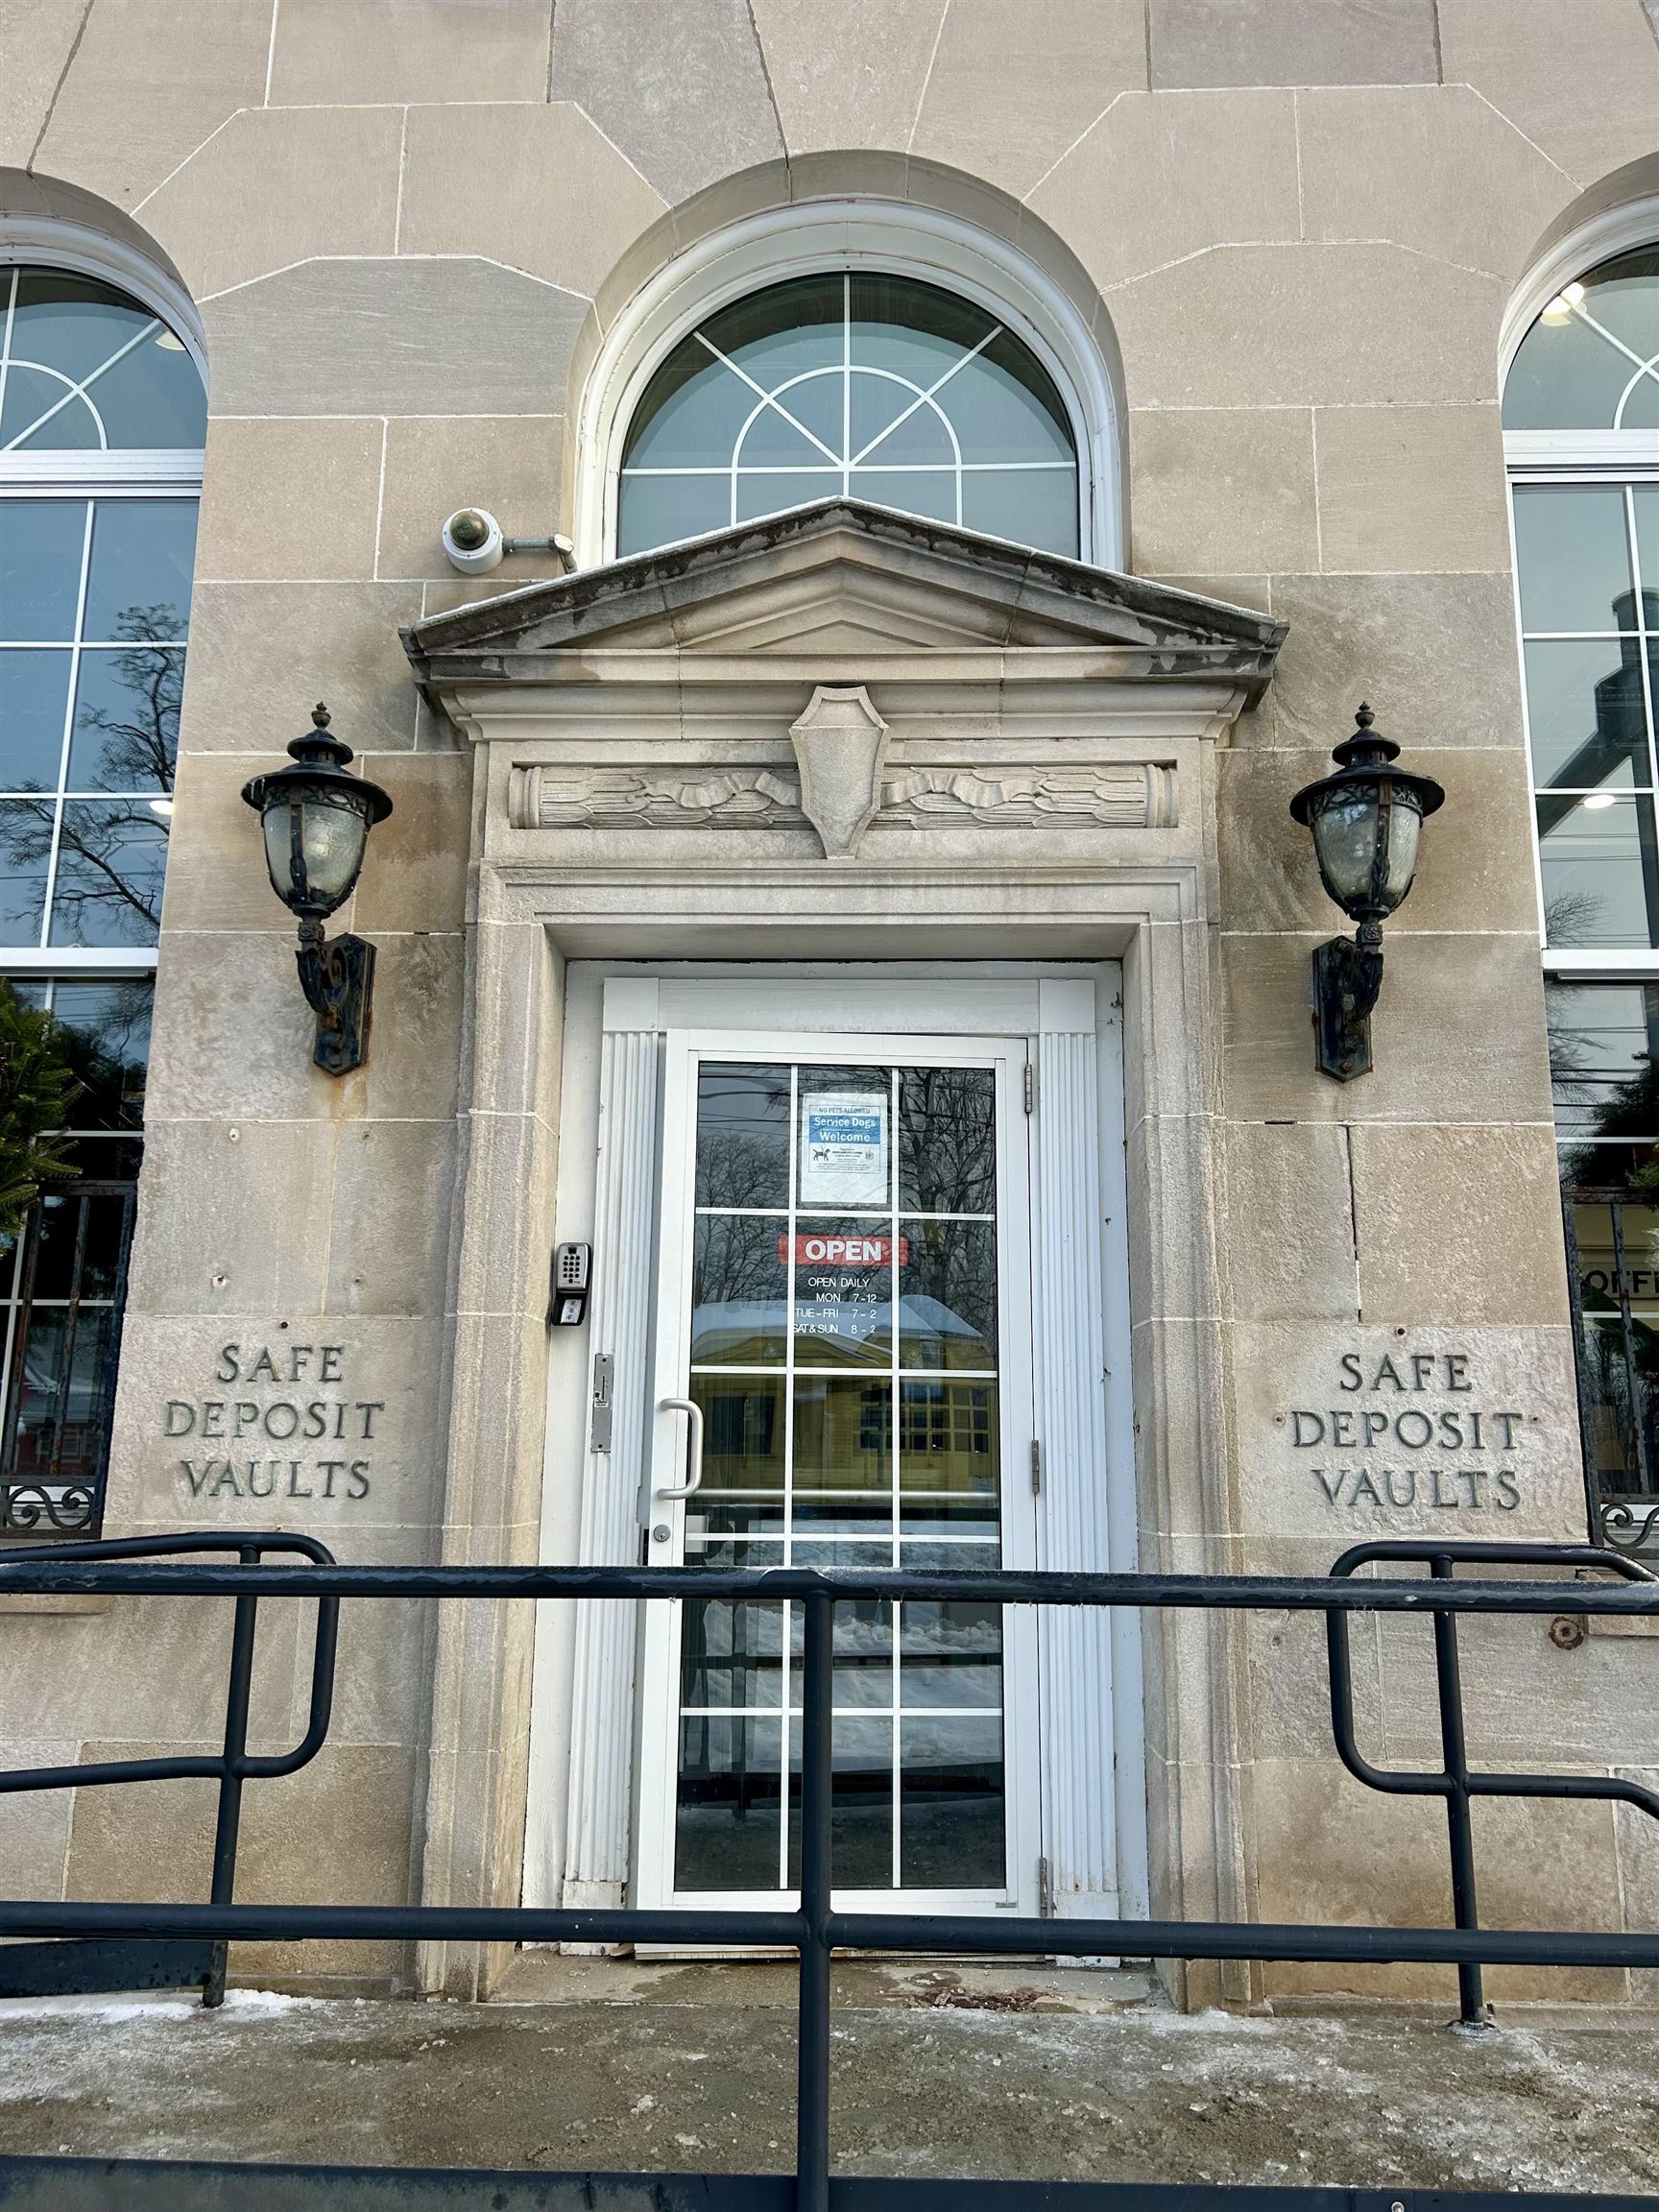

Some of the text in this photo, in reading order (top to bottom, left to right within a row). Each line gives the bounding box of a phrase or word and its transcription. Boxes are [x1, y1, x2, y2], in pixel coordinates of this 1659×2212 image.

[814, 1117, 876, 1129] Service Dogs
[819, 1131, 871, 1142] Welcome
[805, 1239, 882, 1262] OPEN
[808, 1277, 870, 1287] OPEN DAILY
[816, 1292, 841, 1303] MON
[218, 1344, 345, 1382] SAFE
[1340, 1353, 1473, 1392] SAFE
[164, 1400, 386, 1440] DEPOSIT
[1291, 1410, 1524, 1451] DEPOSIT
[180, 1458, 370, 1500] VAULTS
[1311, 1468, 1522, 1510] VAULTS
